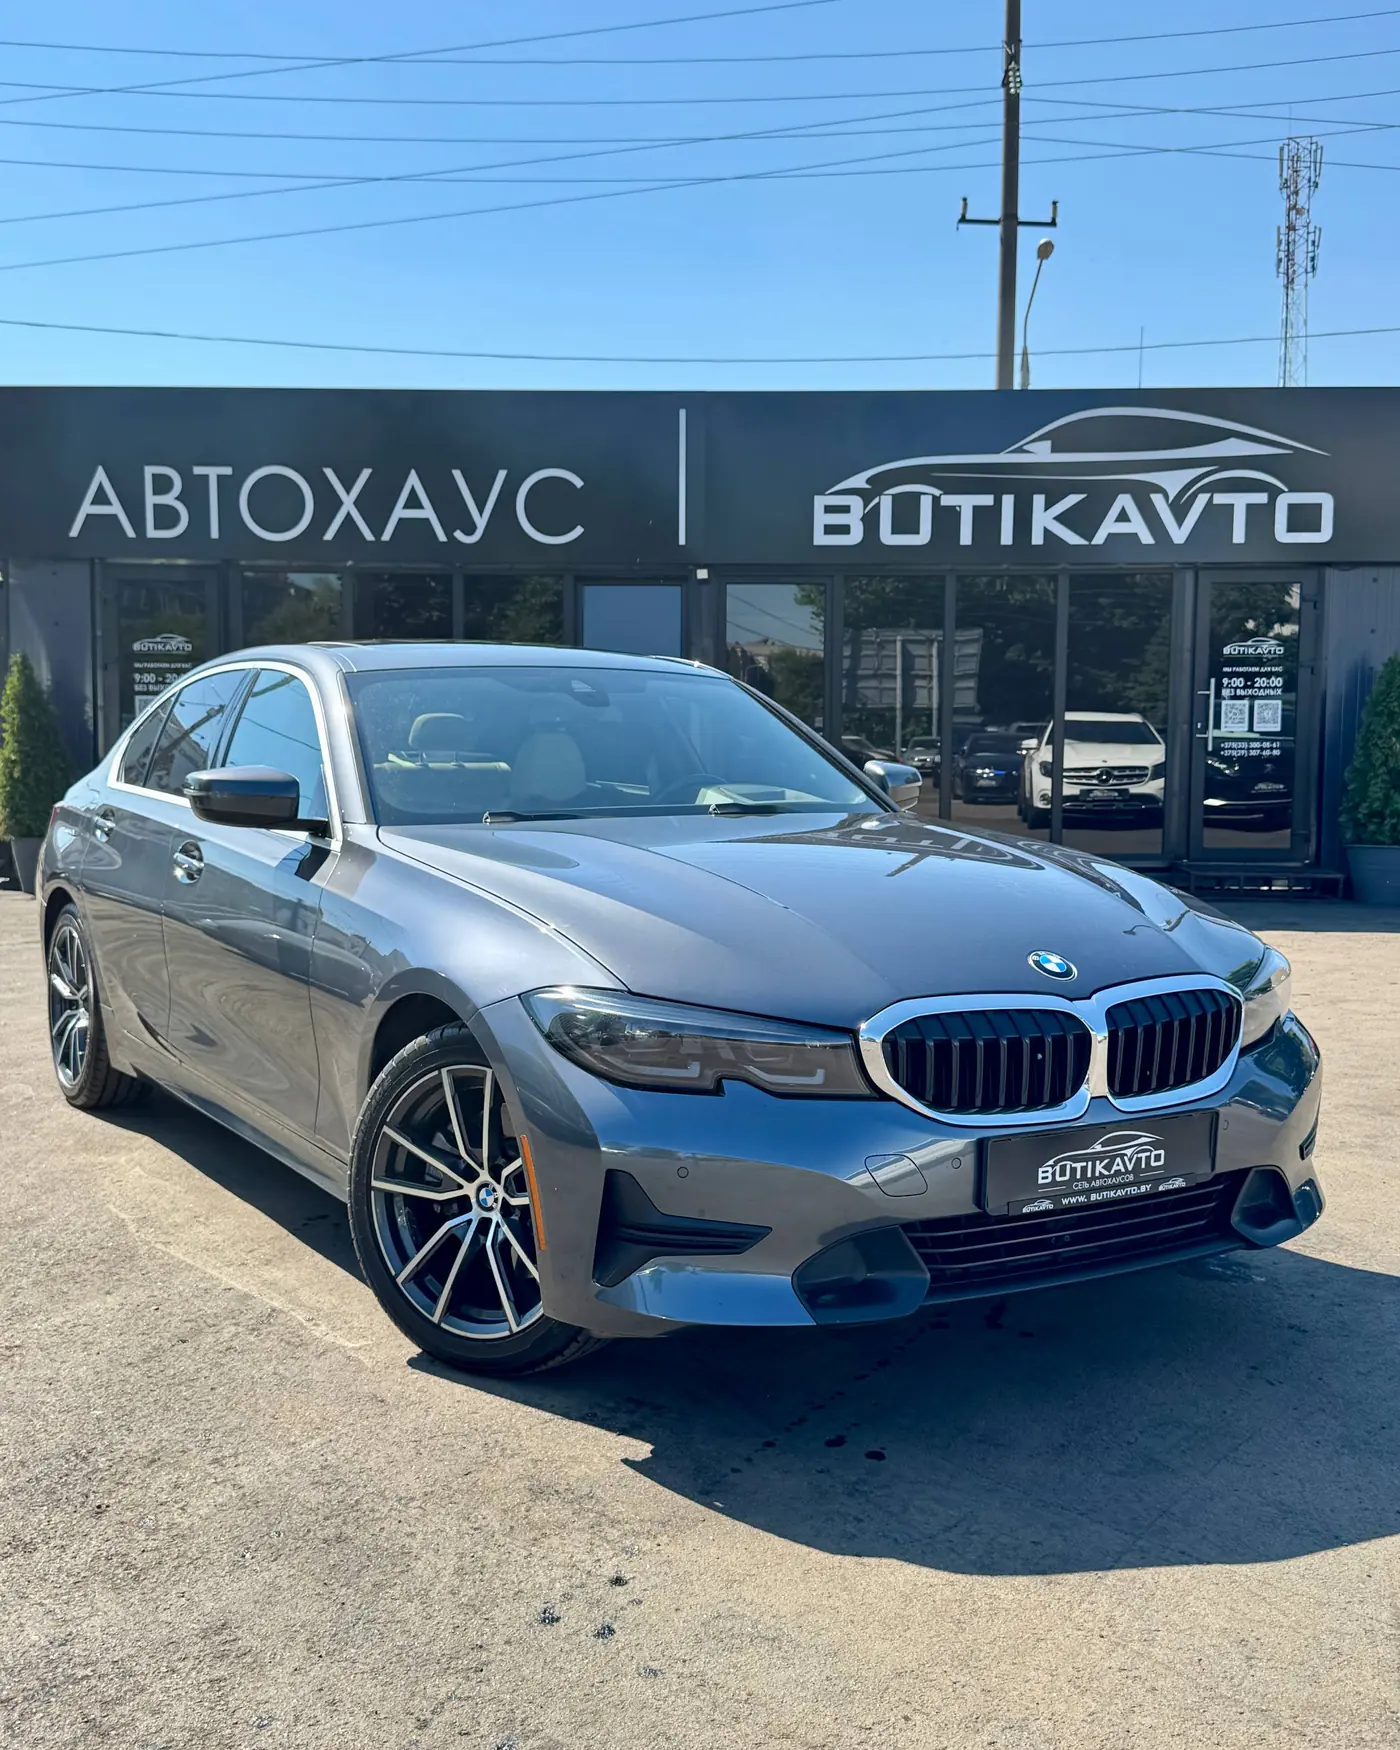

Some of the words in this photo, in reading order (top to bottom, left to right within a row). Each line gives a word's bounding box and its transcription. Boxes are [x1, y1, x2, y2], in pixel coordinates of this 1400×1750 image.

[69, 464, 586, 545] АВТОХАУС
[812, 491, 1335, 546] BUTIKAVTO
[133, 643, 192, 652] BUTIKAVTO
[1223, 646, 1284, 655] BUTIKAVTO
[133, 673, 156, 683] 9:00
[1222, 677, 1244, 688] 9:00
[1254, 677, 1283, 688] 20:00
[1236, 688, 1282, 696] ВЫХОДНЫХ
[1220, 741, 1247, 749] +375(33)
[1220, 749, 1247, 757] +375(29)
[1037, 1149, 1165, 1184] BUTIKAVTO
[1072, 1180, 1090, 1190] СЕТЬ
[1090, 1173, 1134, 1189] АВТОХАУСОВ
[1158, 1181, 1186, 1192] BUTIKAVTO
[1061, 1195, 1088, 1206] WWW.
[1090, 1183, 1152, 1201] BUTIKAVTO.BY
[1022, 1202, 1054, 1214] BUTIKAVTO
